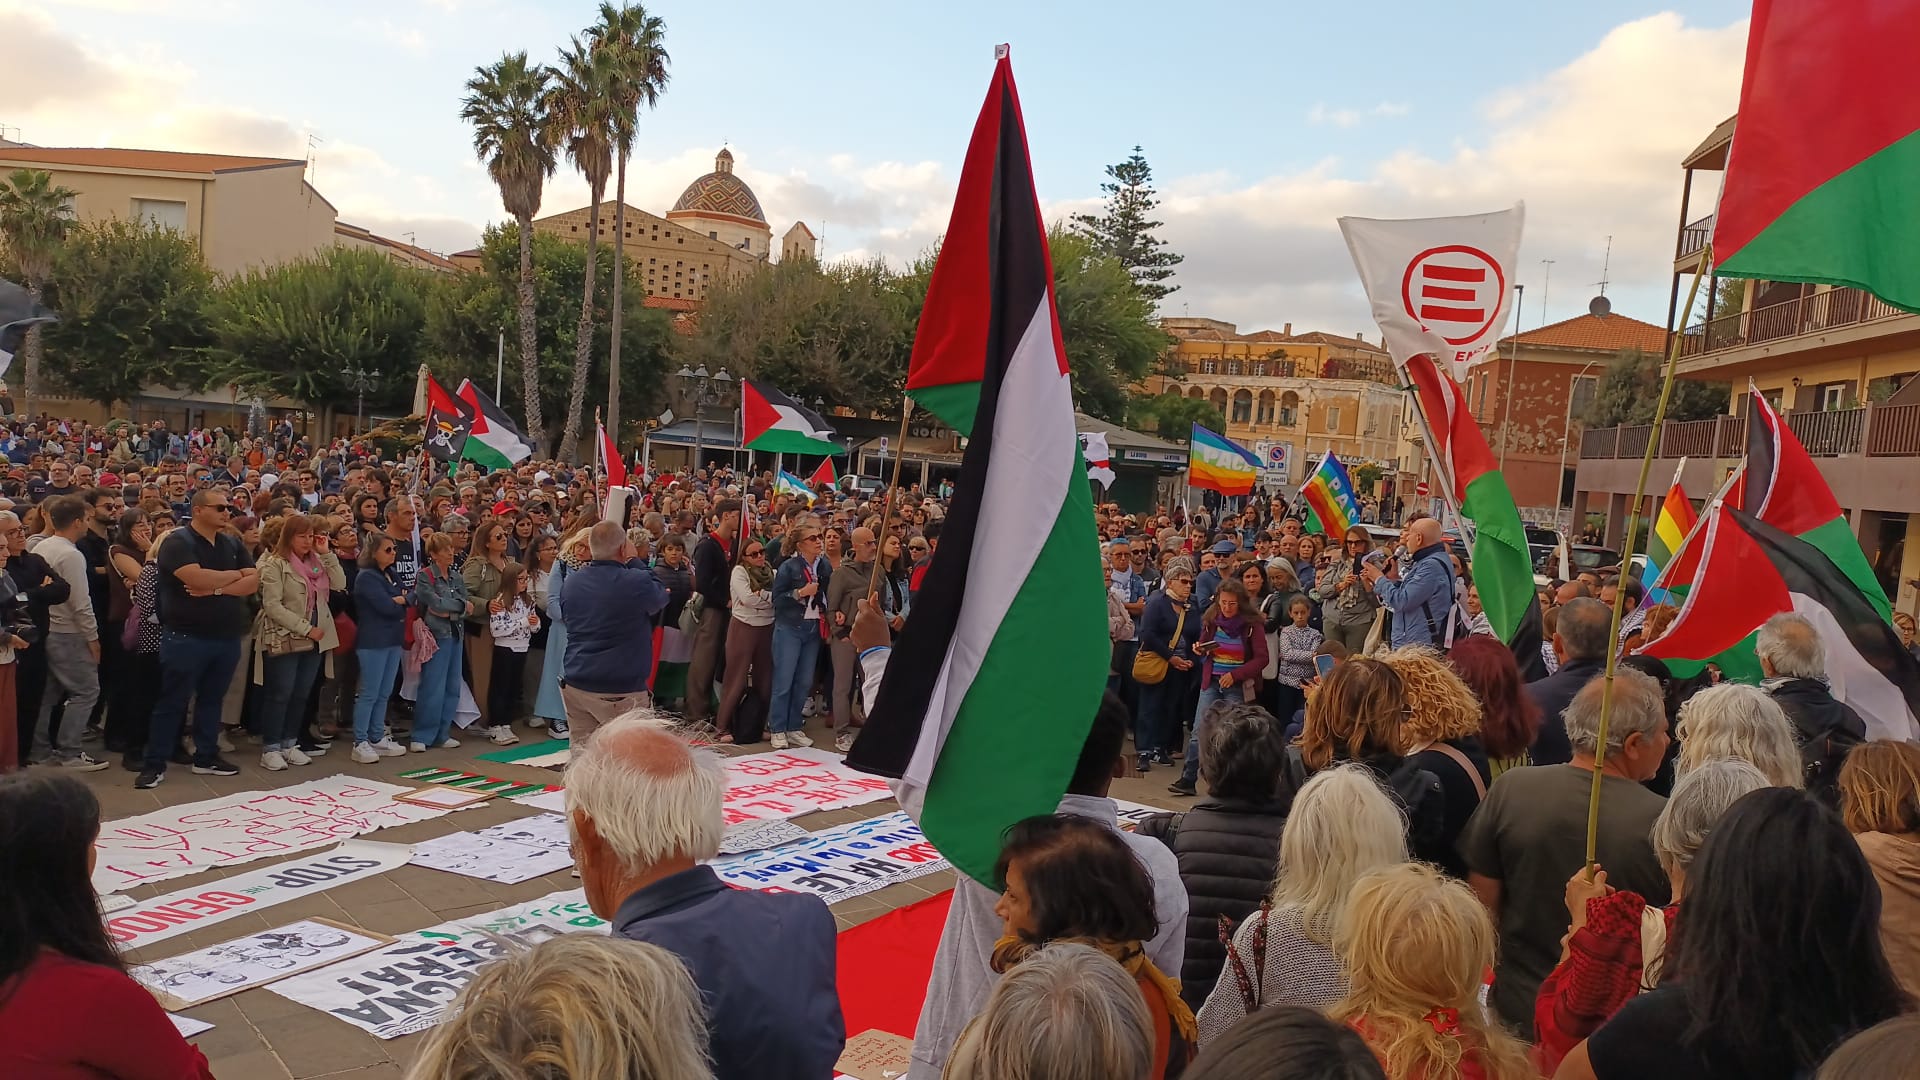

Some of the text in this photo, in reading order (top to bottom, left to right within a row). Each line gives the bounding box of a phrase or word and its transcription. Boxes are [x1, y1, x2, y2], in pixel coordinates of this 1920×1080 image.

[1328, 476, 1358, 521] PAC
[267, 856, 382, 890] STOP
[723, 855, 829, 883] Mari,
[239, 883, 274, 896] THE
